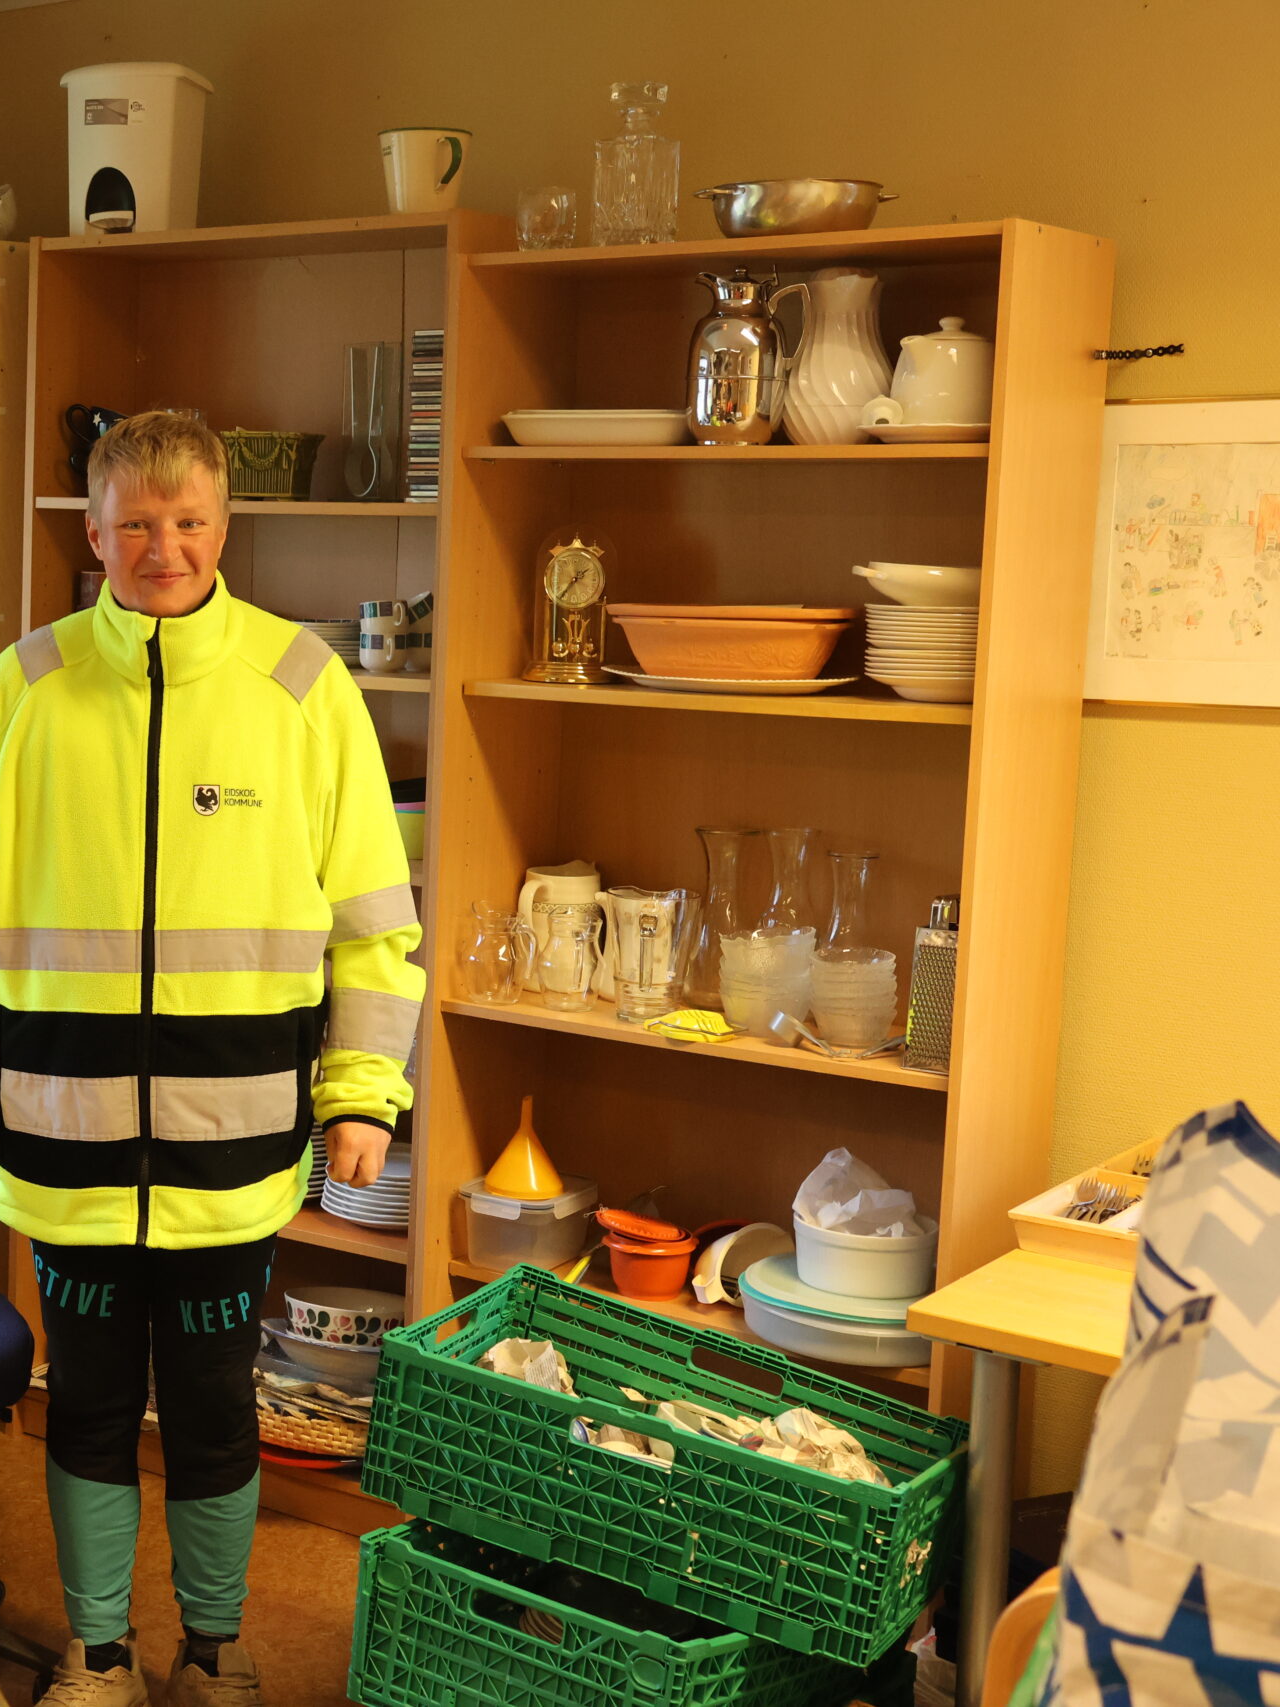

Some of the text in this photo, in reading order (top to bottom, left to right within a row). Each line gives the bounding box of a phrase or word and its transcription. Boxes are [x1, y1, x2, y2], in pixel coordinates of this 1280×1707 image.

[224, 788, 256, 797] EIDSKOG
[224, 798, 263, 808] KOMMUNE
[30, 1241, 251, 1334] CTIVE KEEP
